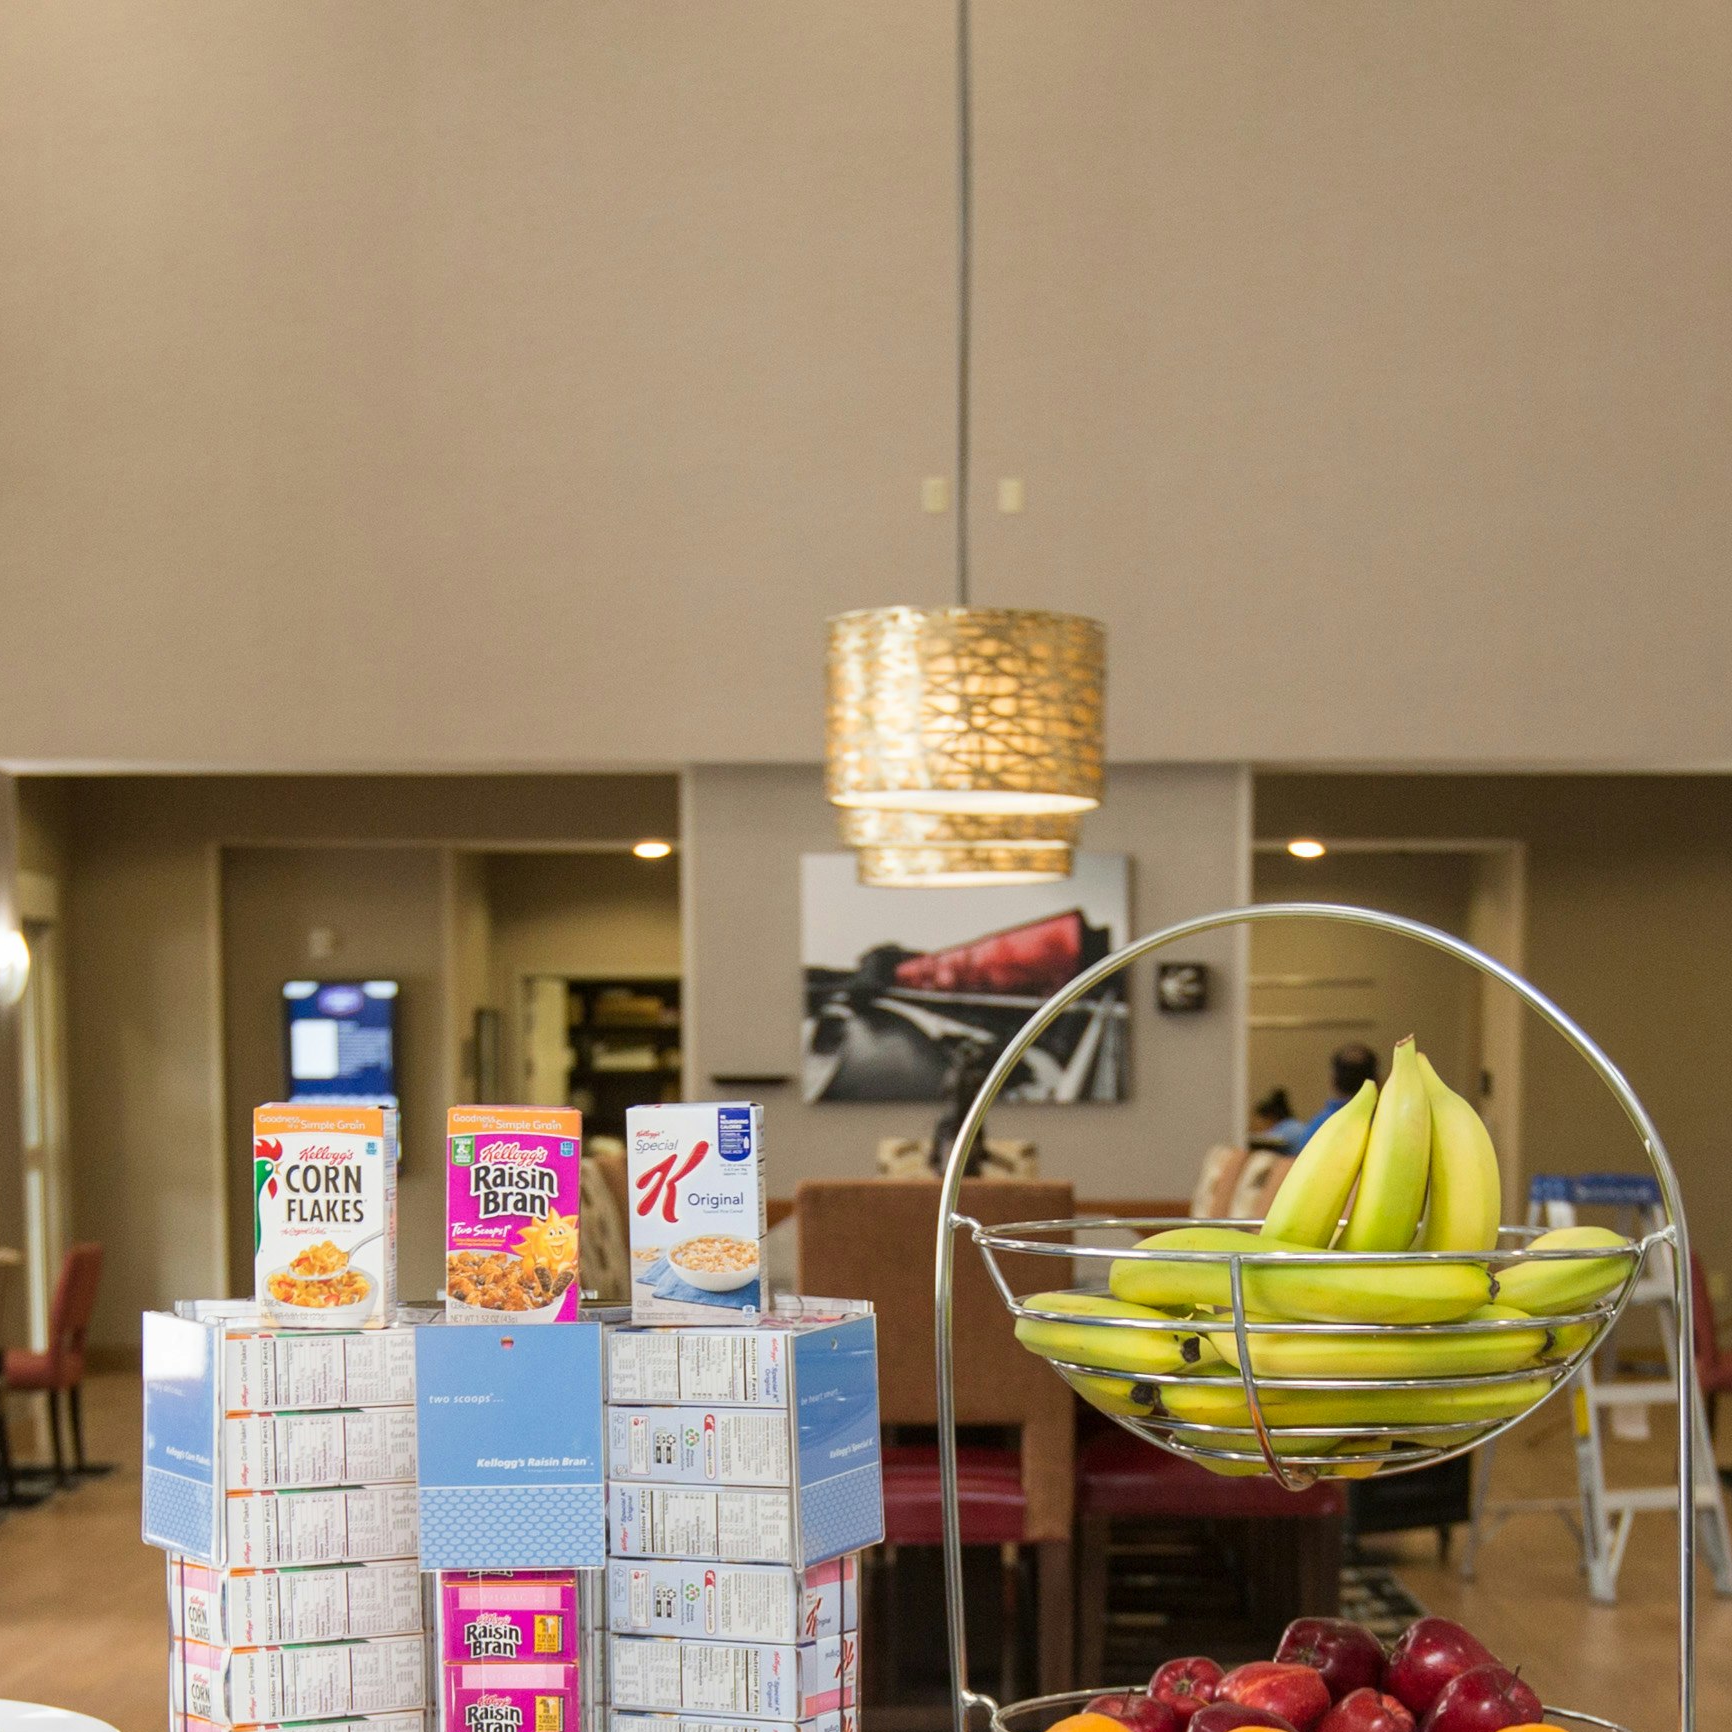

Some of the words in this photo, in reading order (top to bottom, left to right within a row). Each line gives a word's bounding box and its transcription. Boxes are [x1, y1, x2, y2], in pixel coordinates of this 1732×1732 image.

[300, 1120, 335, 1131] Simple
[337, 1119, 366, 1131] Grain
[453, 1113, 496, 1124] Goodness
[496, 1120, 531, 1131] Simple
[533, 1119, 563, 1130] Grain
[481, 1142, 547, 1167] Kellogg's
[635, 1139, 679, 1152] Special
[299, 1145, 355, 1166] Kellogg's
[285, 1164, 363, 1194] CORN
[472, 1164, 556, 1197] Raisin
[635, 1140, 710, 1223] K
[482, 1190, 548, 1217] Bran
[687, 1192, 744, 1210] Original
[287, 1199, 365, 1223] FLAKES
[451, 1222, 472, 1236] Two
[428, 1394, 451, 1404] two
[476, 1457, 525, 1470] Kellogg's
[527, 1457, 560, 1467] Raisin
[188, 1606, 207, 1624] CORN
[466, 1624, 520, 1643] Raisin
[472, 1641, 515, 1657] Bran
[191, 1683, 210, 1702] CORN
[467, 1705, 521, 1724] Raisin
